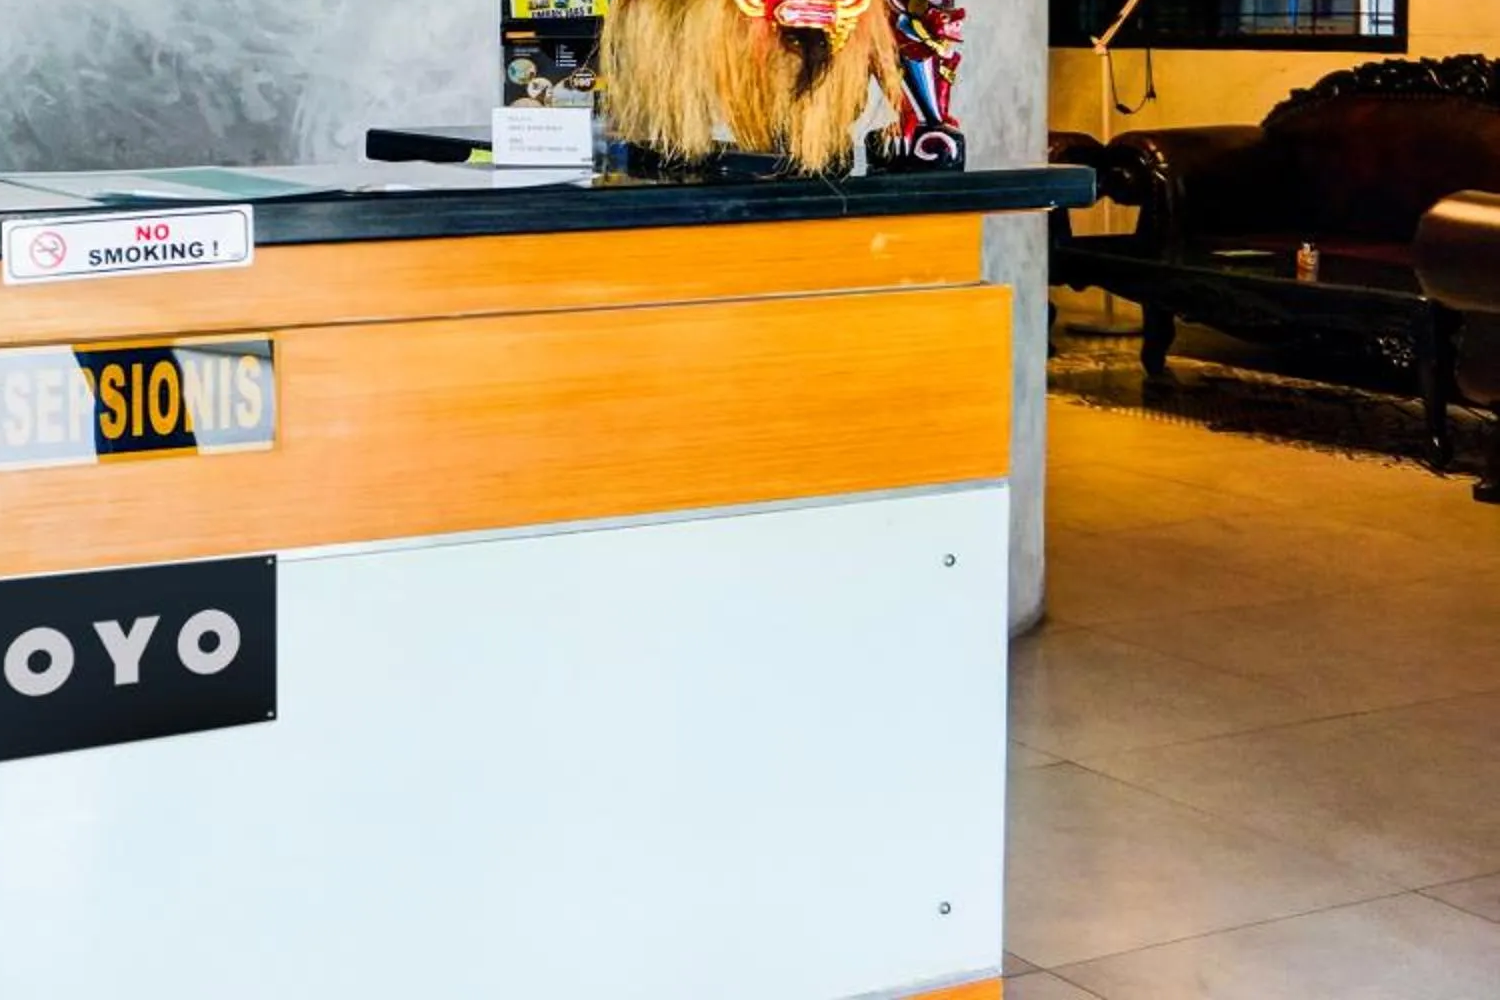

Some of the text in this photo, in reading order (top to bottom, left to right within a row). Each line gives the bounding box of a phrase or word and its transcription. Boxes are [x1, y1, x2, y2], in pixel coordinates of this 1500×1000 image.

[136, 224, 171, 242] NO
[88, 241, 205, 267] SMOKING
[3, 608, 241, 697] OYO
